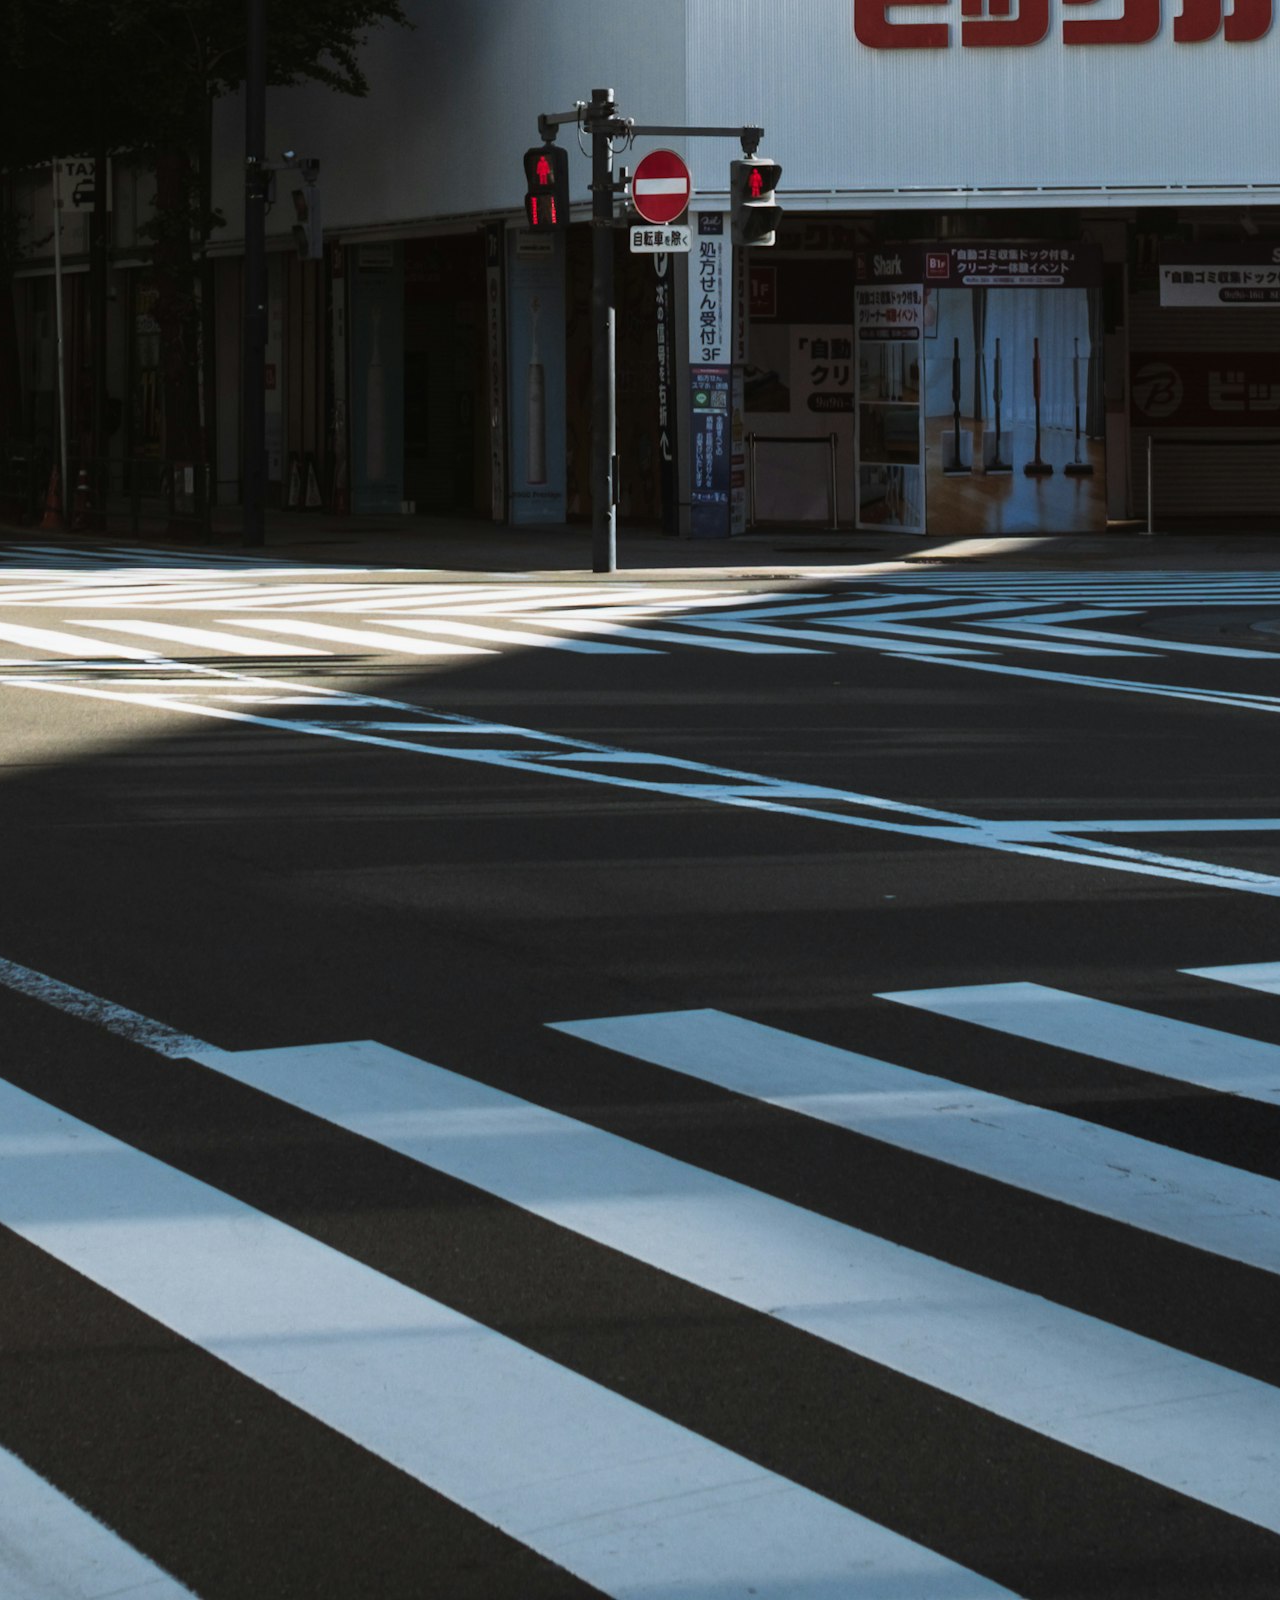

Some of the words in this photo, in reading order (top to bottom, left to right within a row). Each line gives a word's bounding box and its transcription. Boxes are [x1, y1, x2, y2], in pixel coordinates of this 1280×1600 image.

[633, 231, 689, 247] 自転車を除く
[873, 254, 902, 276] Shark
[699, 241, 718, 345] 処方せん受付
[701, 347, 721, 362] 3F
